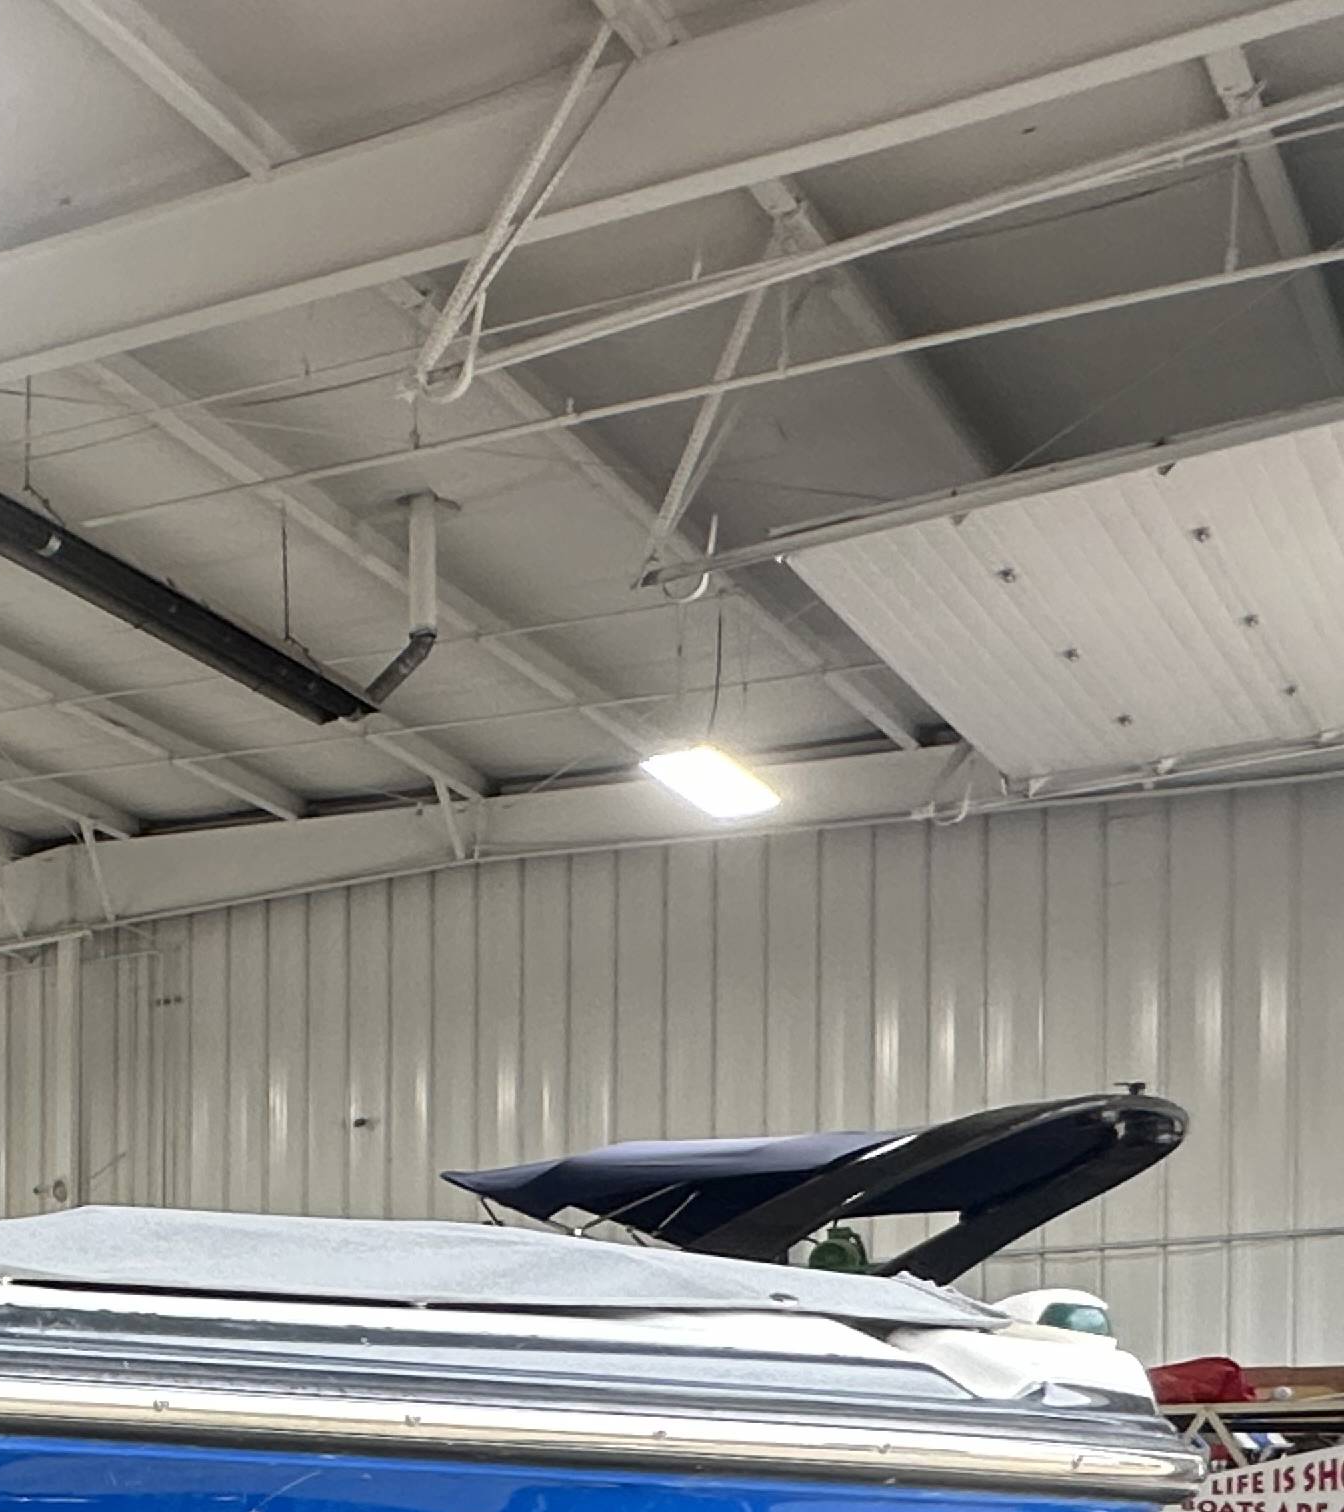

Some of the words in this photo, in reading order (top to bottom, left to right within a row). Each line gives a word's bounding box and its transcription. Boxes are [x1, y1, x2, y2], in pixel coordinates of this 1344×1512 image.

[1212, 1471, 1264, 1496] LIFE
[1273, 1467, 1296, 1494] IS
[1304, 1458, 1344, 1493] SH
